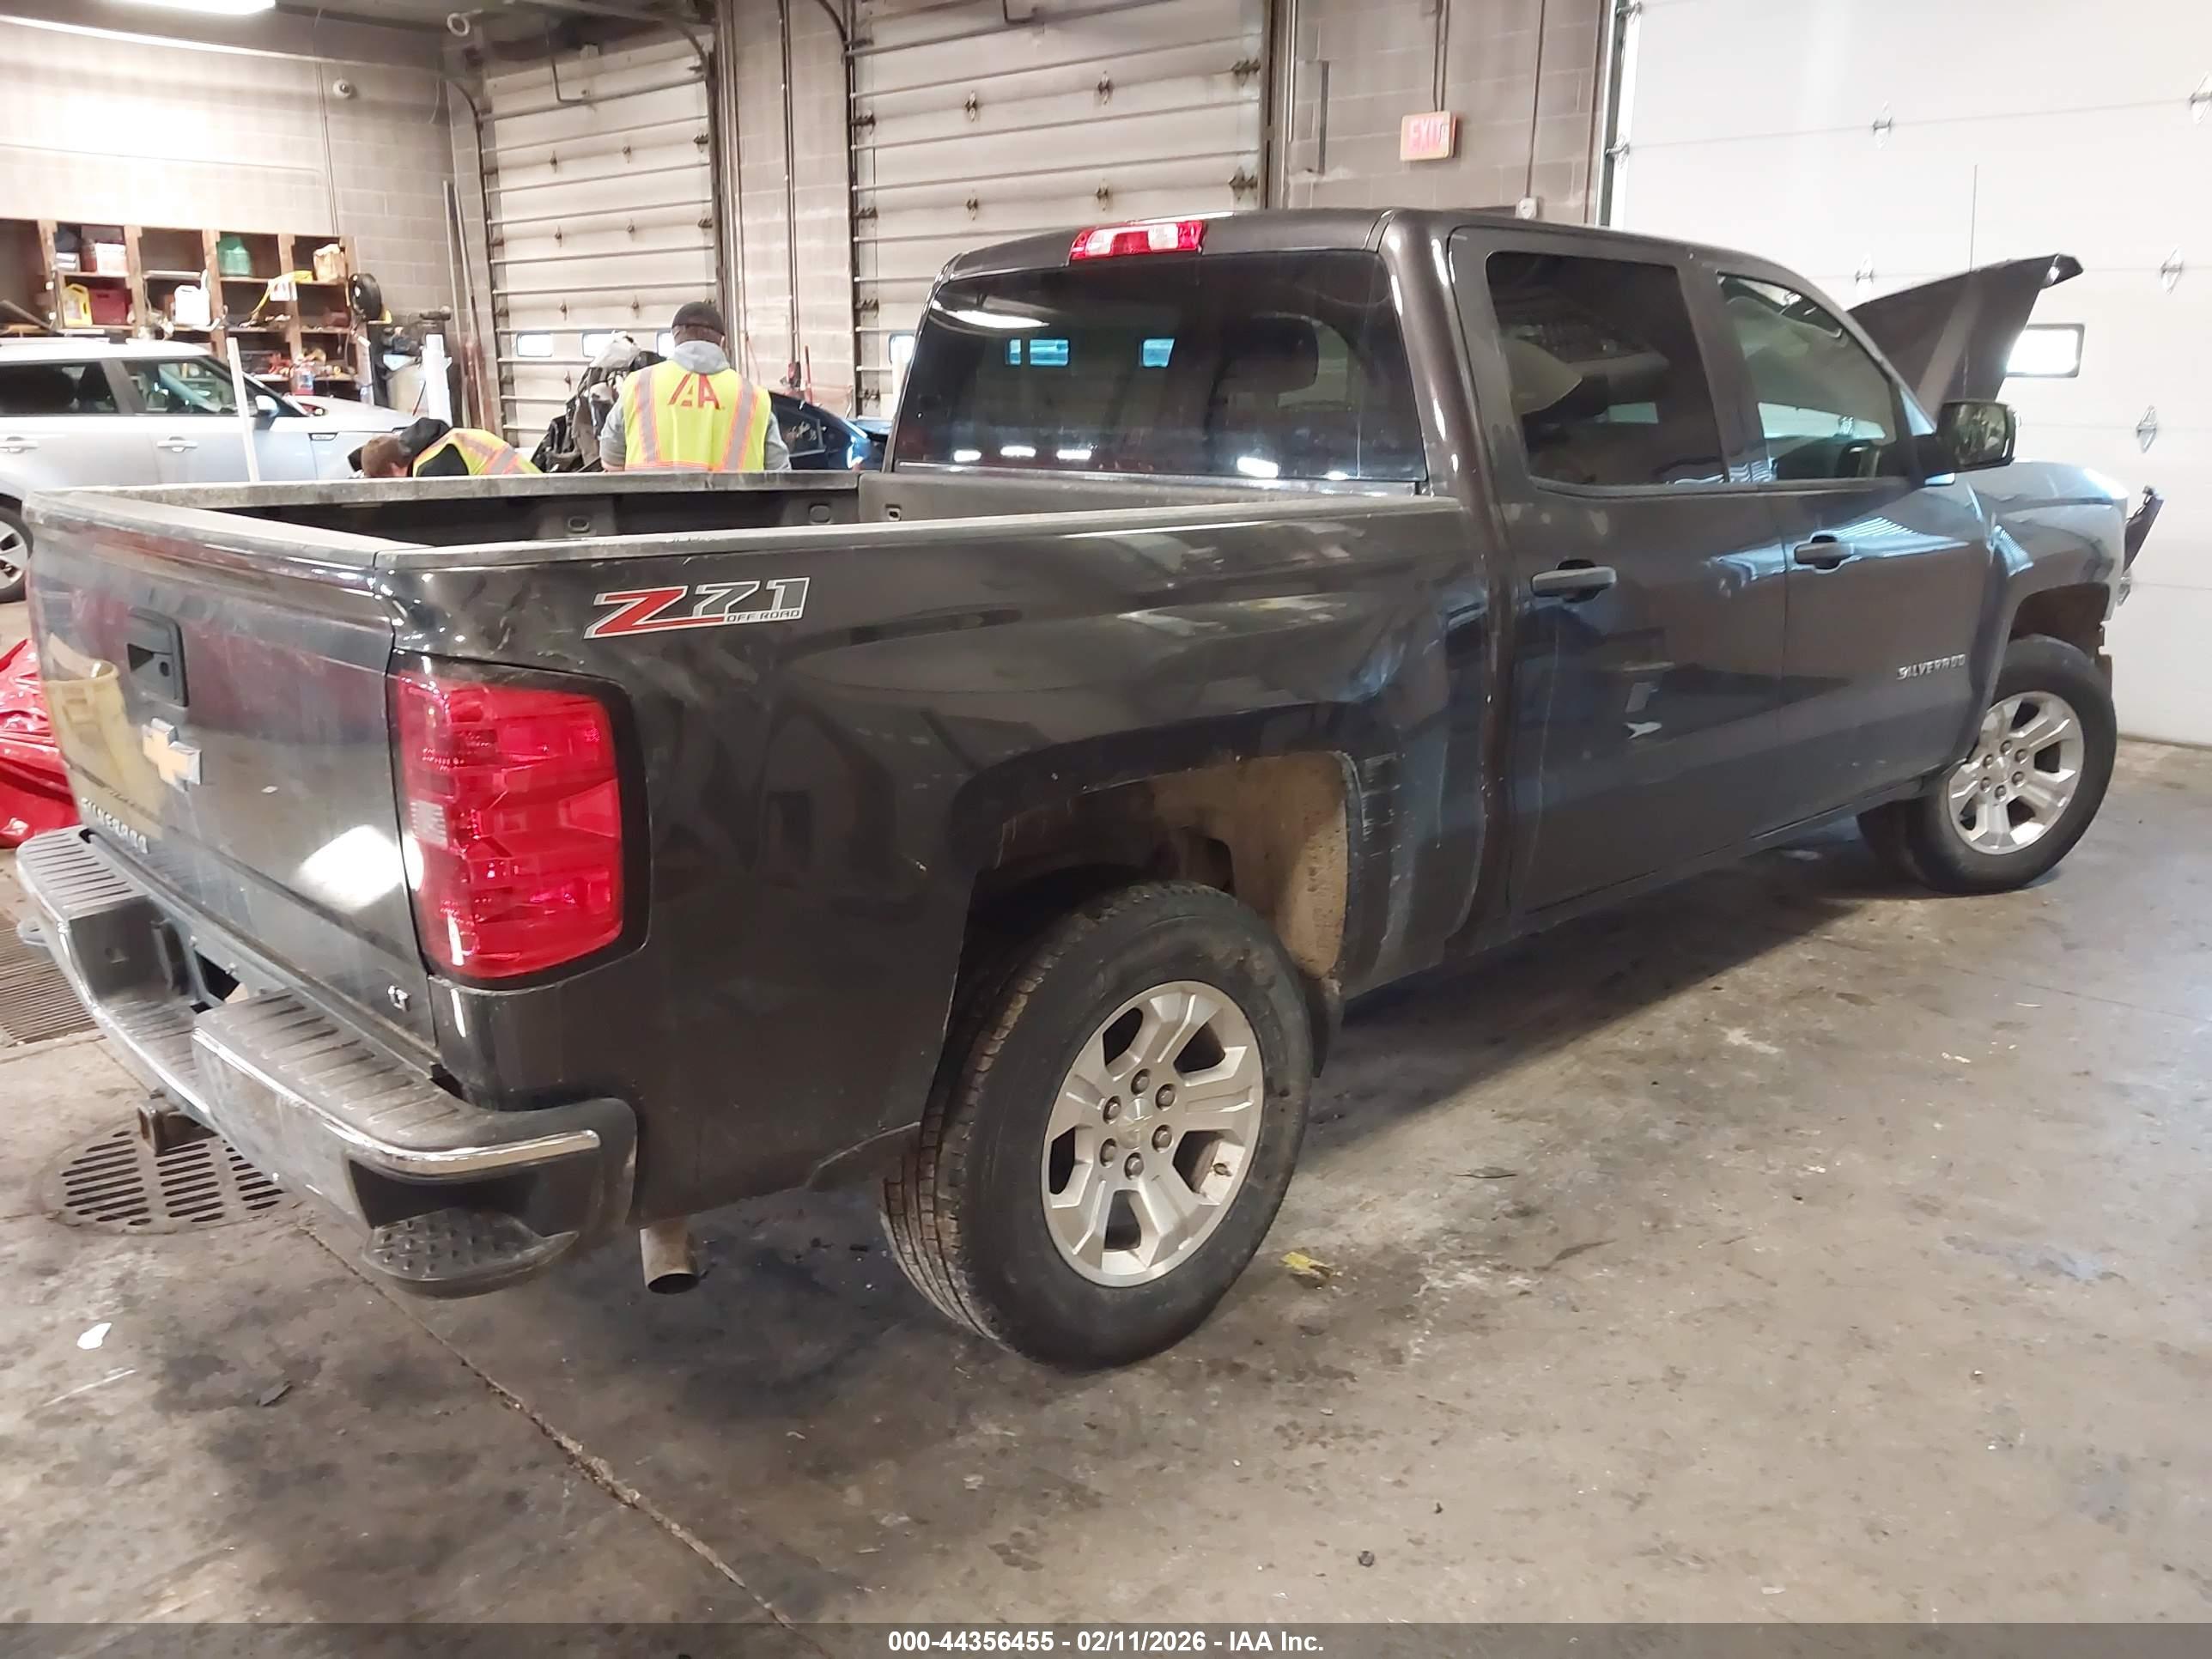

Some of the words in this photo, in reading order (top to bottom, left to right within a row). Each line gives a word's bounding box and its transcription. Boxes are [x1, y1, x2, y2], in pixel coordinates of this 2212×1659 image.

[1409, 117, 1449, 151] EXIT
[584, 577, 811, 639] Z71
[726, 611, 757, 623] OFF
[760, 609, 800, 620] ROAD
[1896, 653, 1966, 680] SILVERADO
